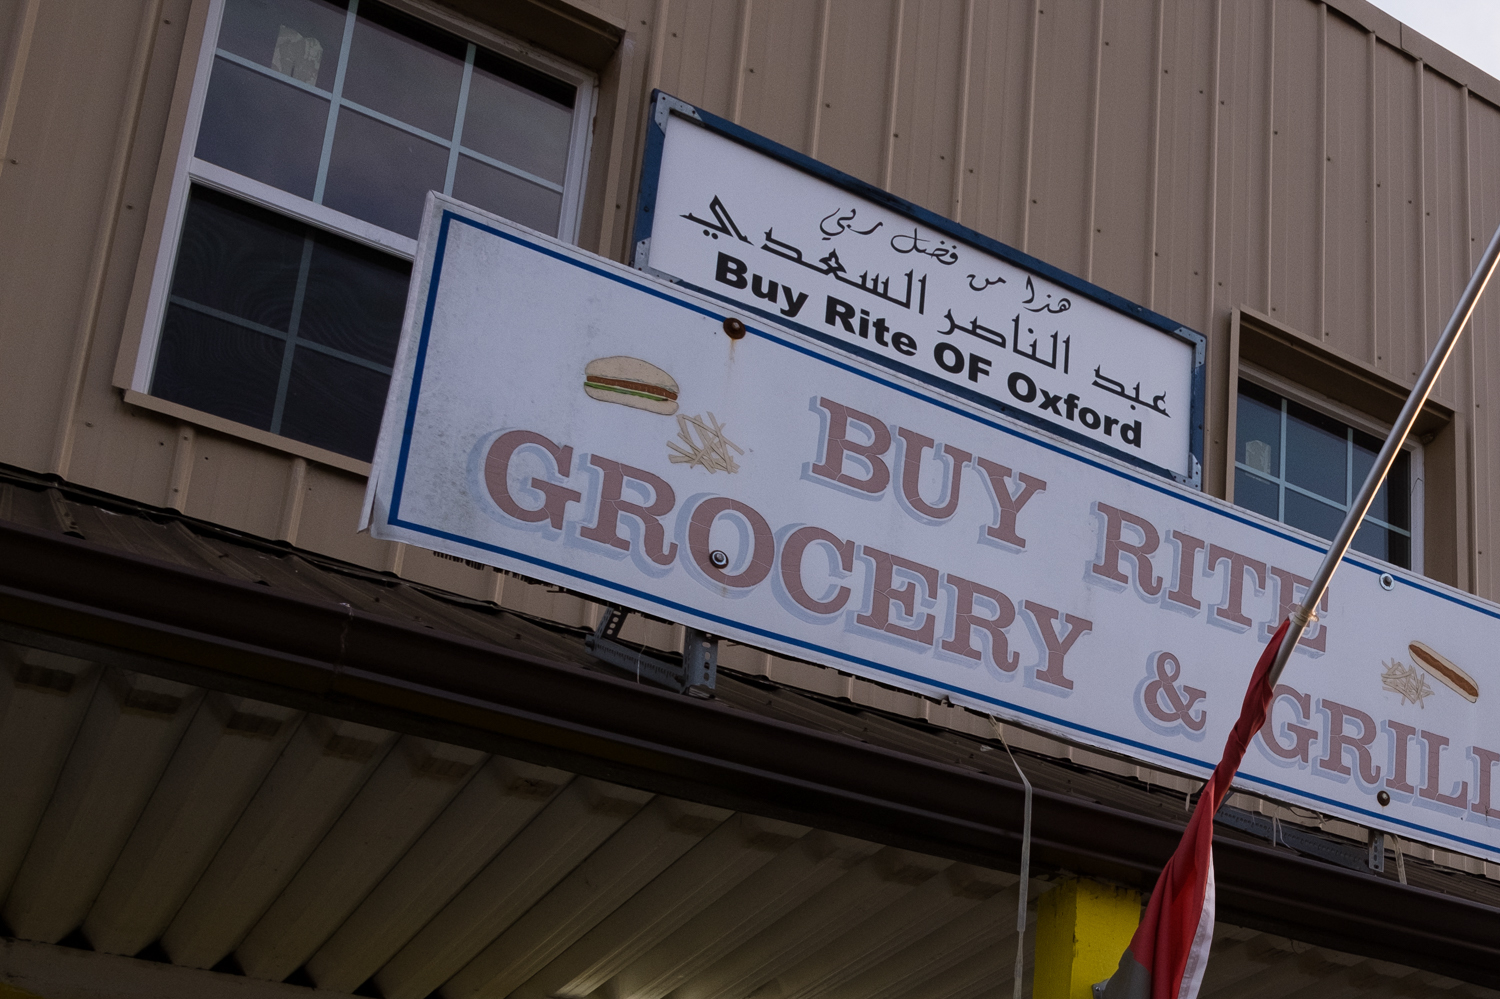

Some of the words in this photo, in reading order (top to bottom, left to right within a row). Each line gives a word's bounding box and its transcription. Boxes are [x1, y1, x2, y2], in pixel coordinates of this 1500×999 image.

[714, 251, 809, 317] Buy
[824, 296, 918, 357] Rite
[933, 341, 992, 384] OF
[1007, 371, 1143, 448] Oxford
[468, 427, 1093, 696] GROCERY
[1135, 651, 1206, 737] &
[803, 396, 1047, 551] BUY
[1086, 503, 1330, 657] RITE
